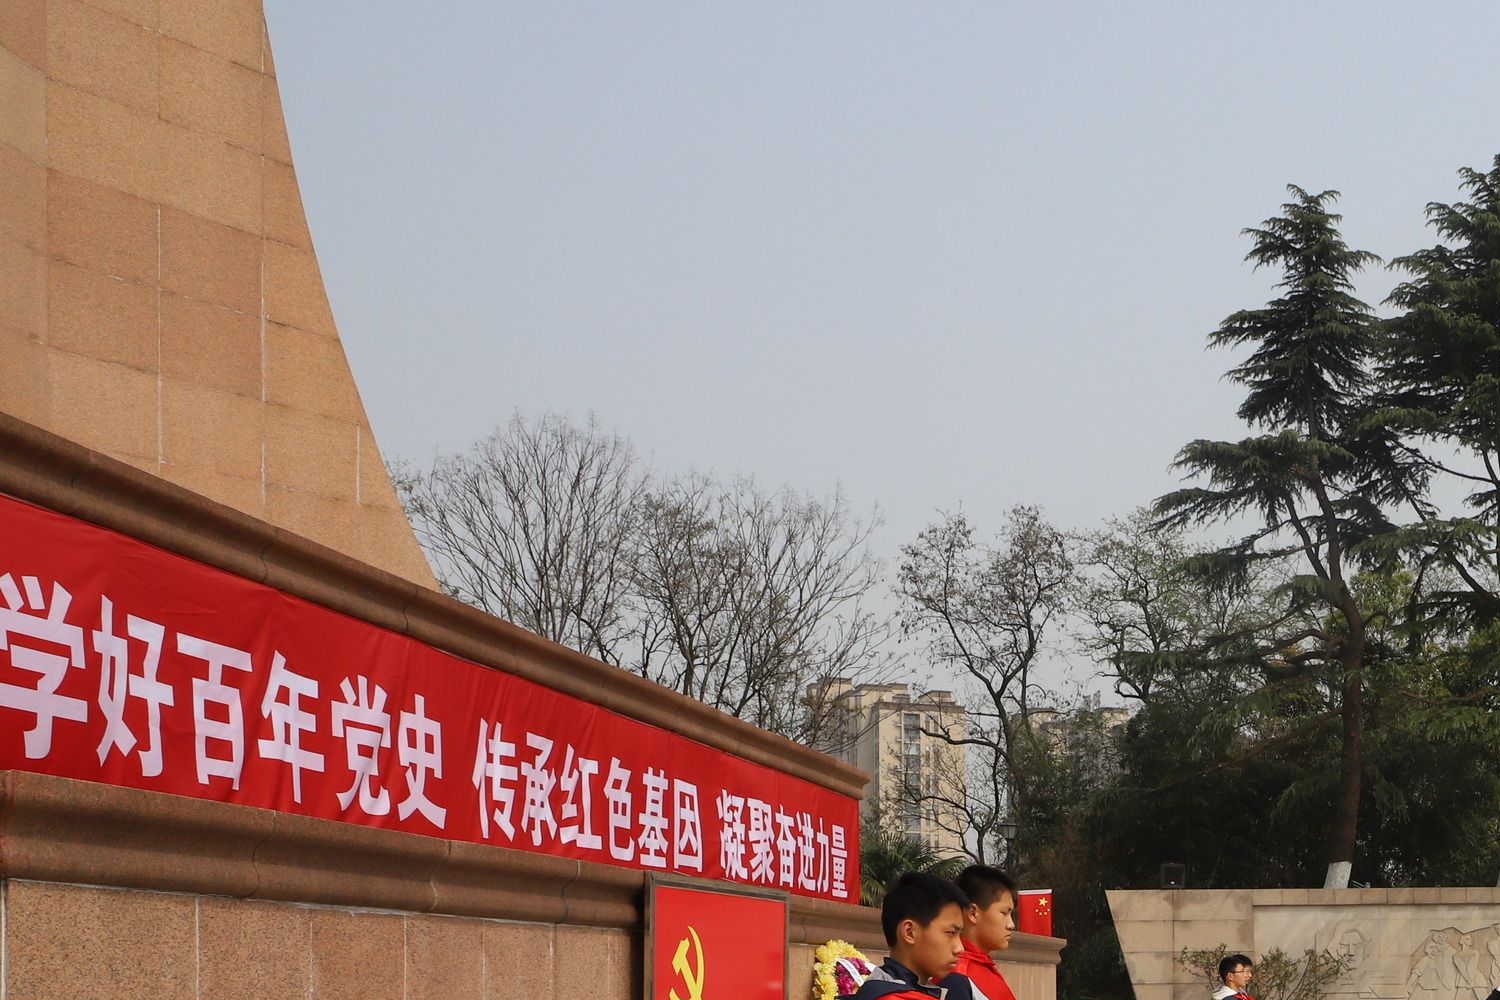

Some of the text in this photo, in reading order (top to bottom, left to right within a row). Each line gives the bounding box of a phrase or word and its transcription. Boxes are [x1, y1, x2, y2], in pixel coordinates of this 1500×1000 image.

[0, 572, 849, 899] 学好百年党史 传承红色基因 凝聚奋进力量
